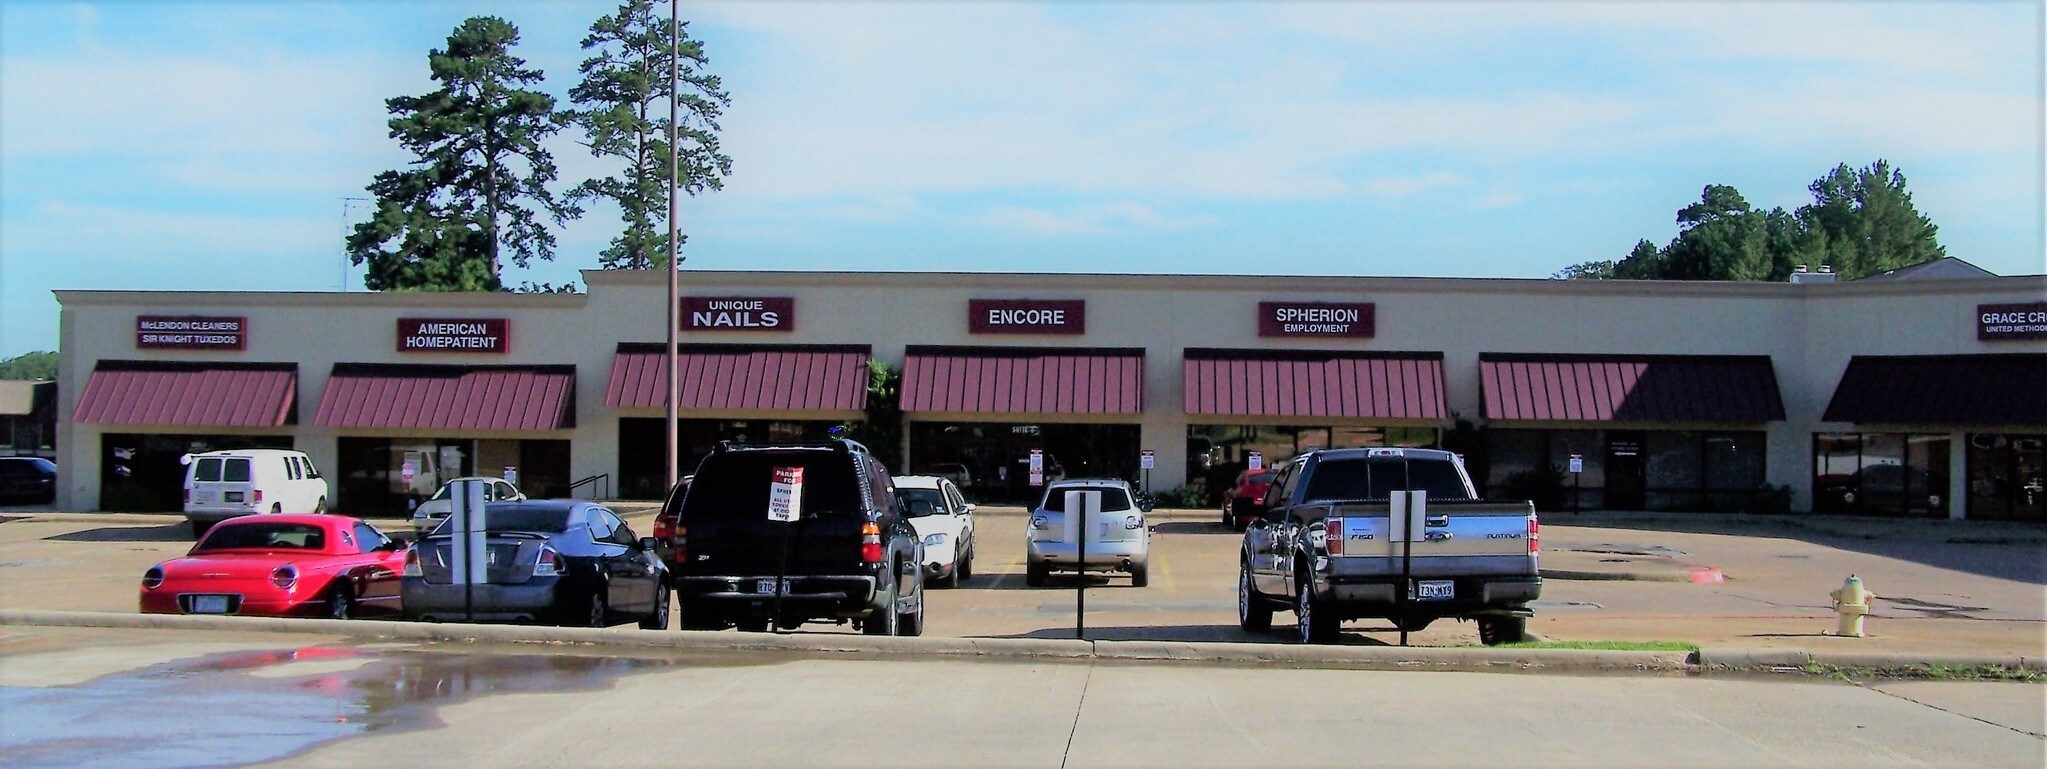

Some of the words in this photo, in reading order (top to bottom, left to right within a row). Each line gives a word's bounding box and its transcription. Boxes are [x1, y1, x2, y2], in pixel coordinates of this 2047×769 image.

[709, 301, 763, 310] UNIQUE
[693, 311, 779, 327] NAILS
[989, 309, 1065, 324] ENCORE
[1276, 308, 1358, 322] SPHERION
[1982, 312, 2026, 324] GRACE
[2028, 312, 2047, 323] CR
[191, 321, 238, 331] CLEANERS
[418, 323, 486, 335] AMERICAN
[1284, 324, 1350, 333] EMPLOYMENT
[1986, 325, 2013, 333] UNITED
[143, 335, 158, 343] SIR
[159, 335, 193, 344] KNIGHT
[195, 335, 236, 344] TUXEDOS
[406, 336, 497, 348] HOMEPATIENT
